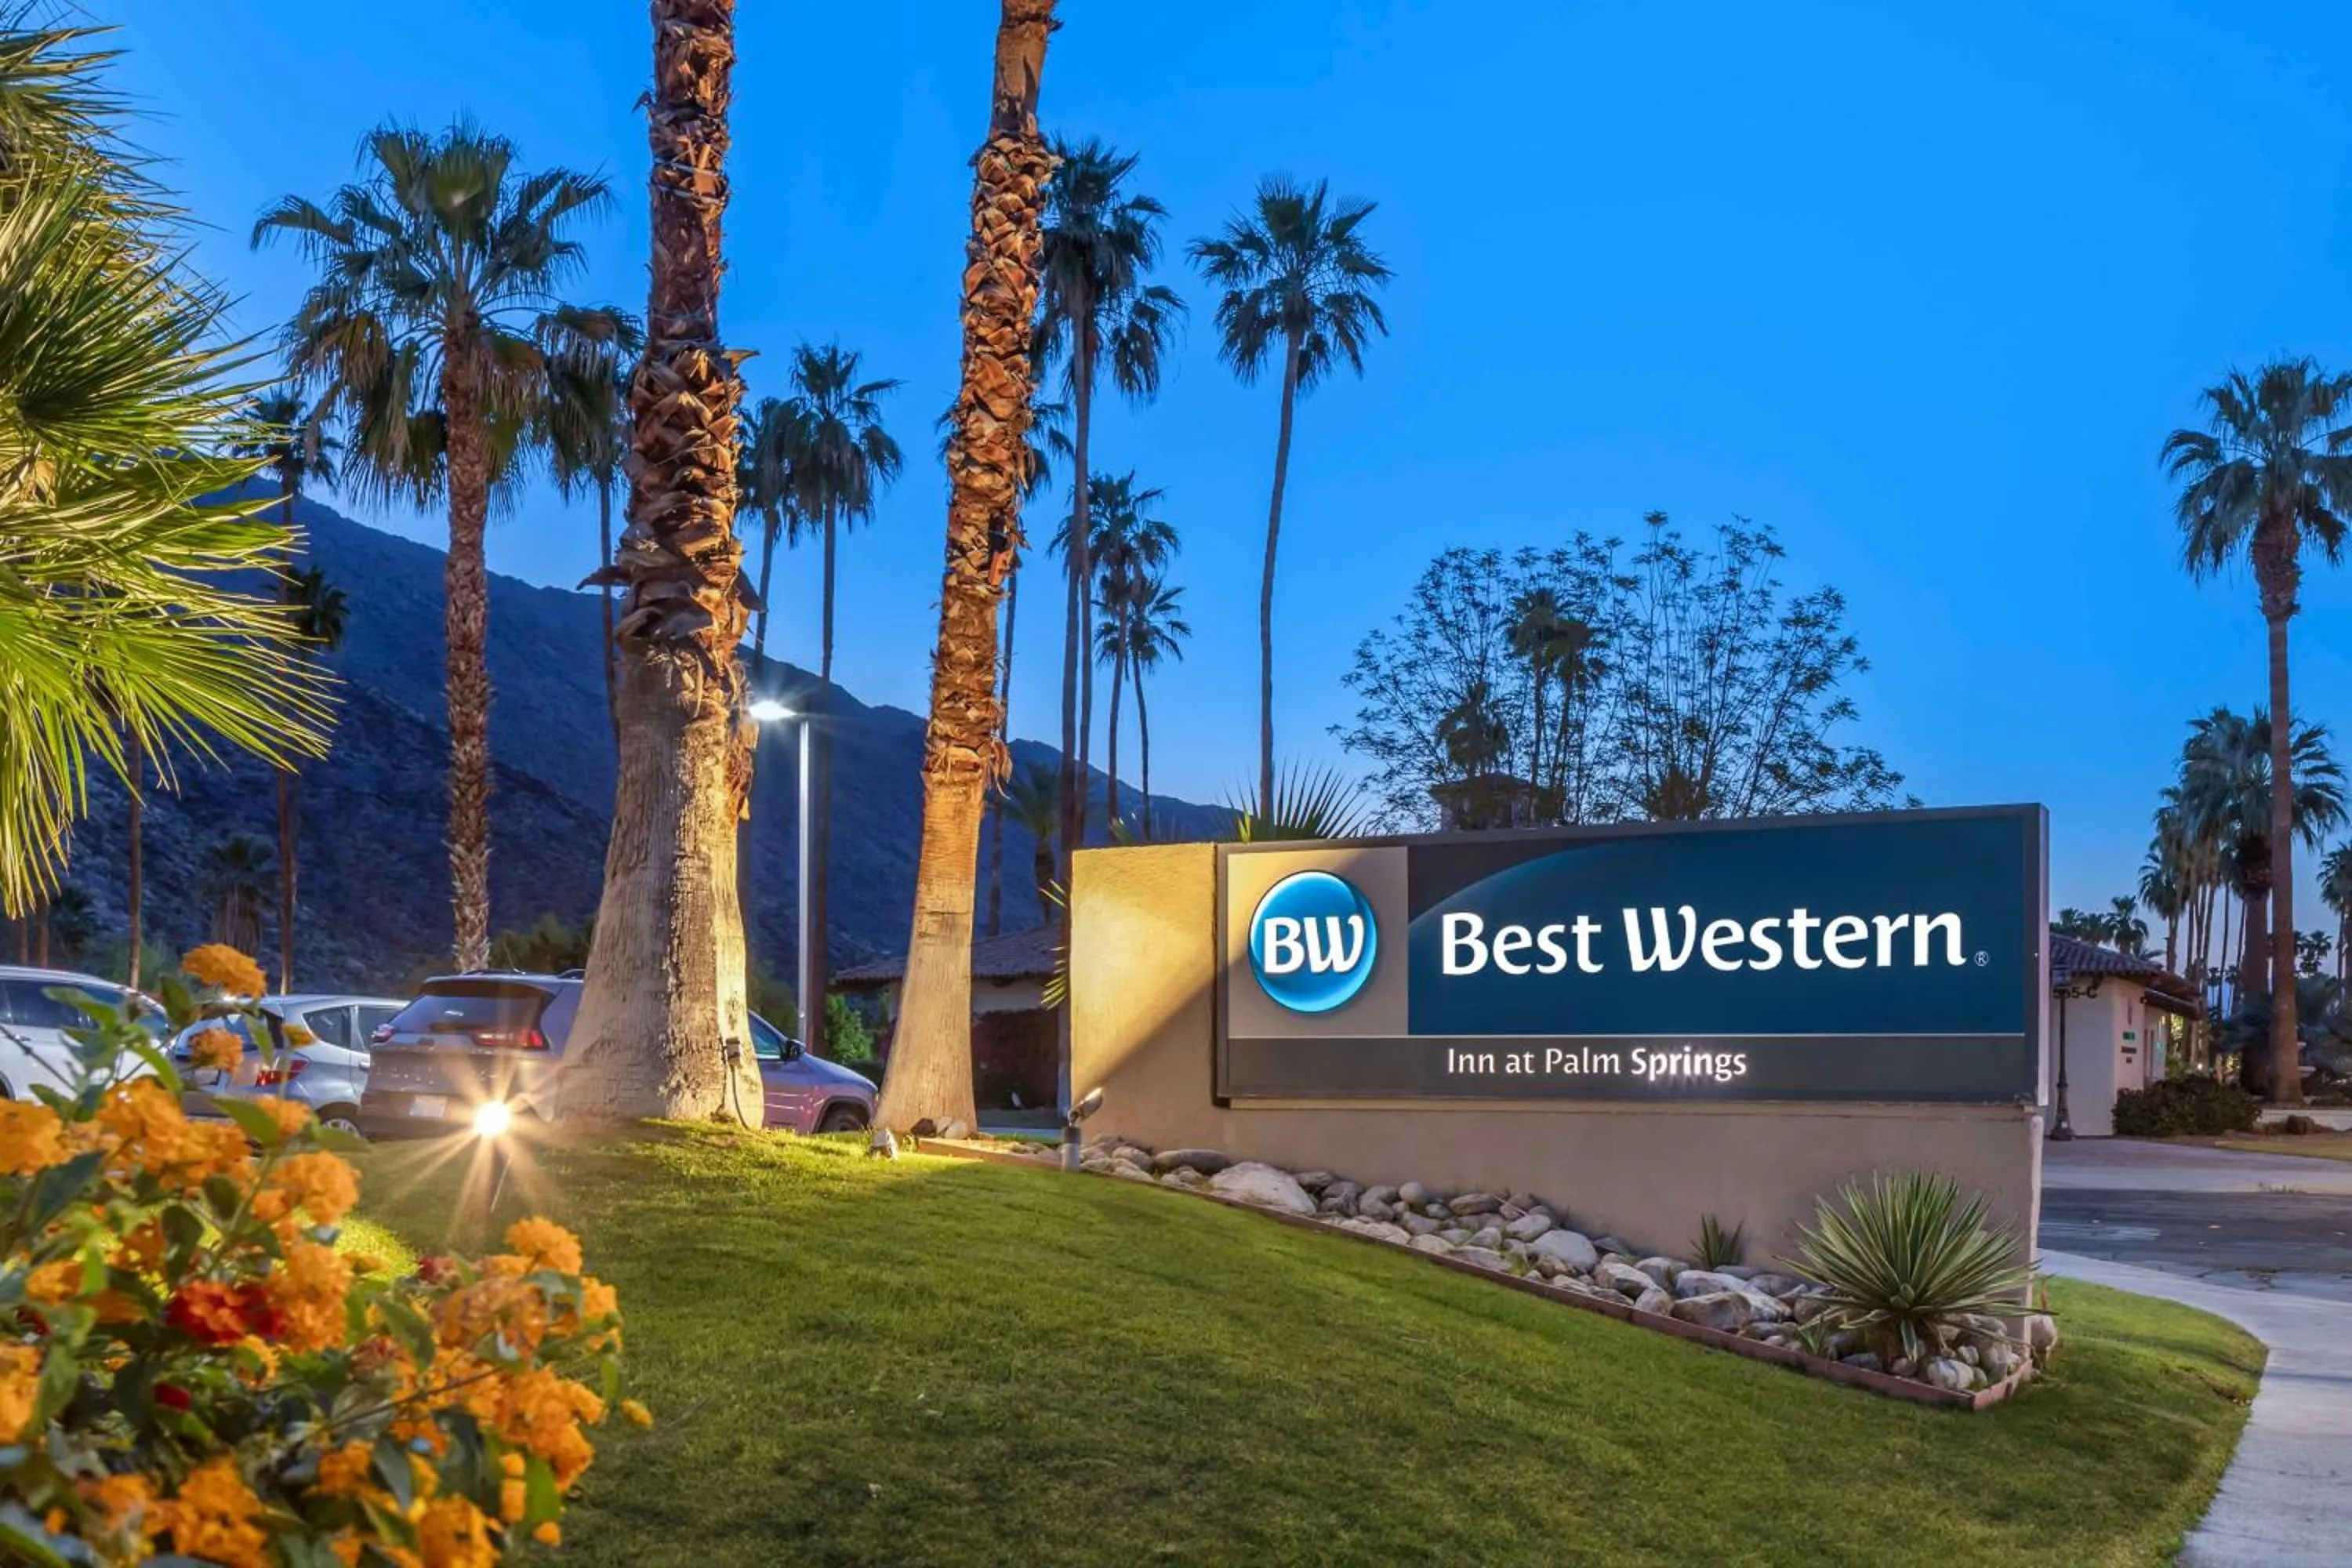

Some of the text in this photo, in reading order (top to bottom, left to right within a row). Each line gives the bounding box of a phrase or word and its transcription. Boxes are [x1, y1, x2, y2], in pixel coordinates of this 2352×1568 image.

[1264, 915, 1363, 974] BW
[1442, 912, 1603, 975] Best
[1623, 905, 1966, 971] Western
[1448, 1045, 1748, 1083] Inn at Palm Springs
